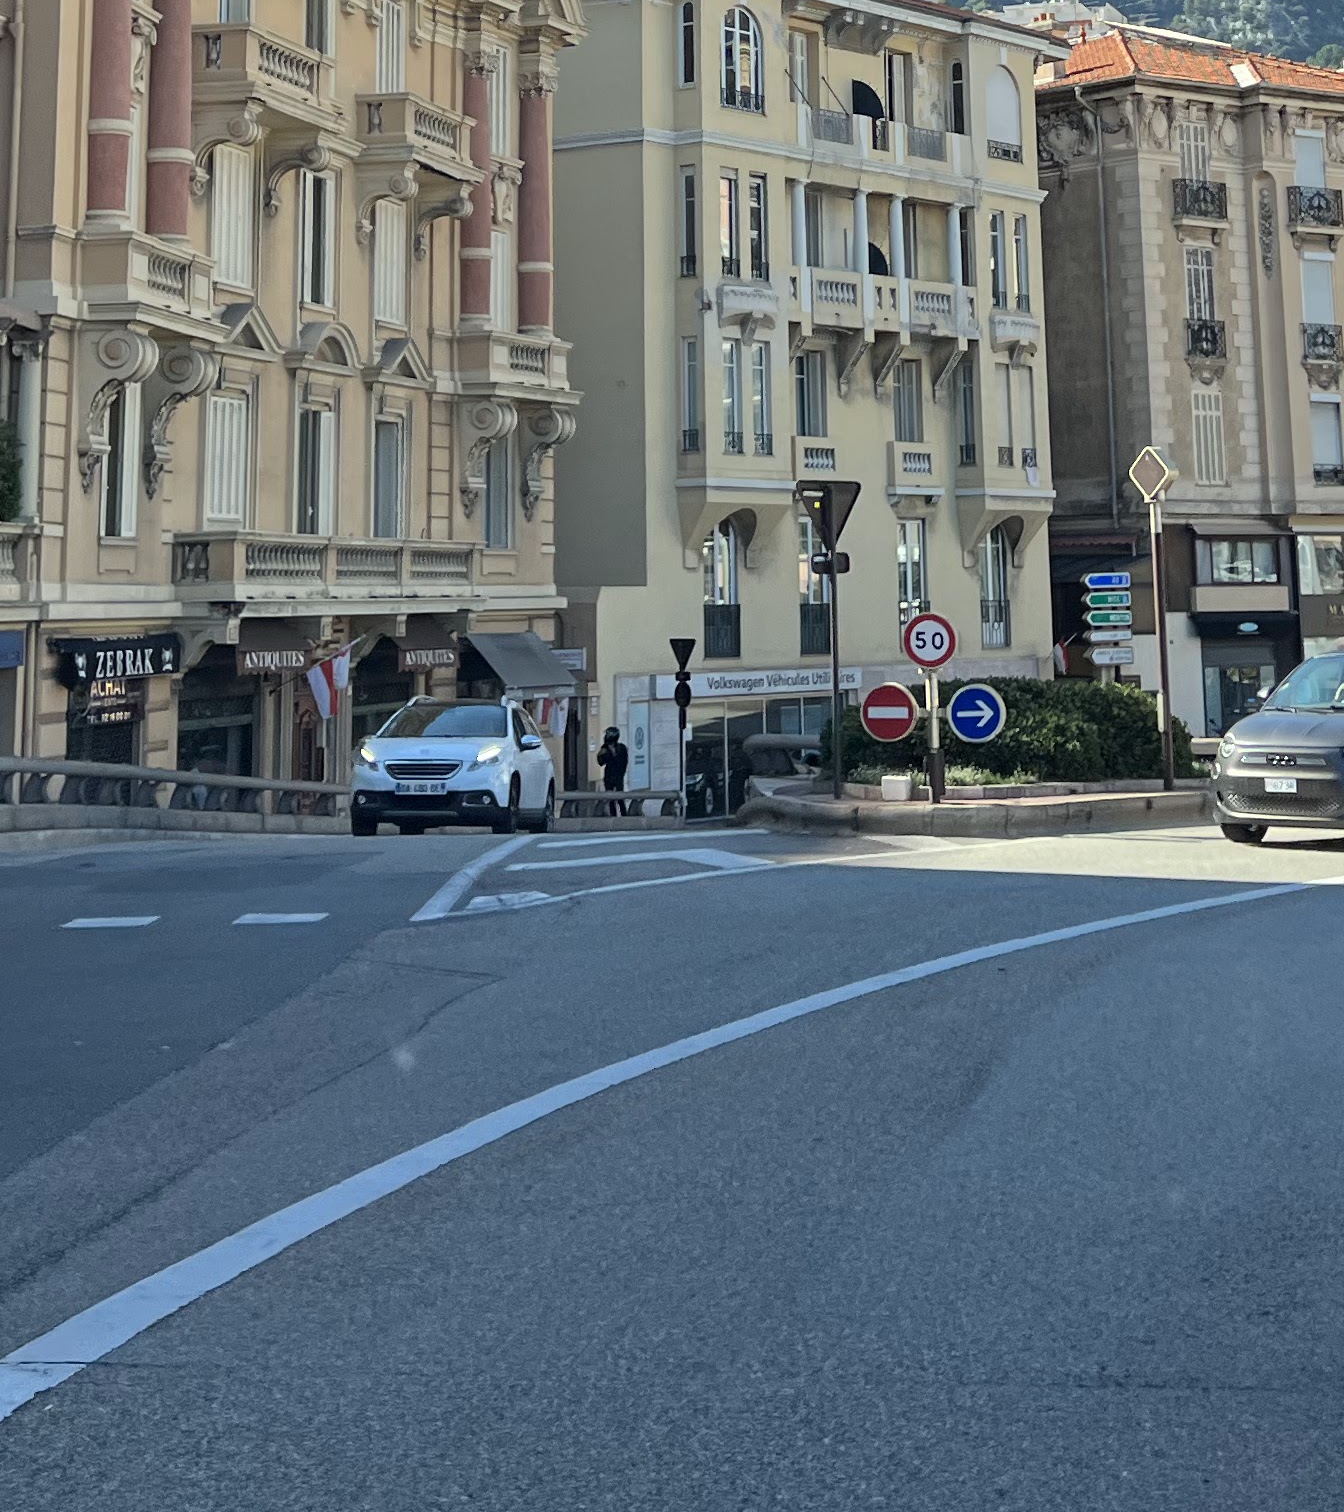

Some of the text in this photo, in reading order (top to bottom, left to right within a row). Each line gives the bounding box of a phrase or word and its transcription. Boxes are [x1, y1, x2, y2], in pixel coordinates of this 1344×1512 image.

[915, 631, 944, 650] 50
[96, 648, 154, 678] ZEBRAK
[707, 676, 764, 691] Volkswagen
[766, 671, 810, 688] Véhicules
